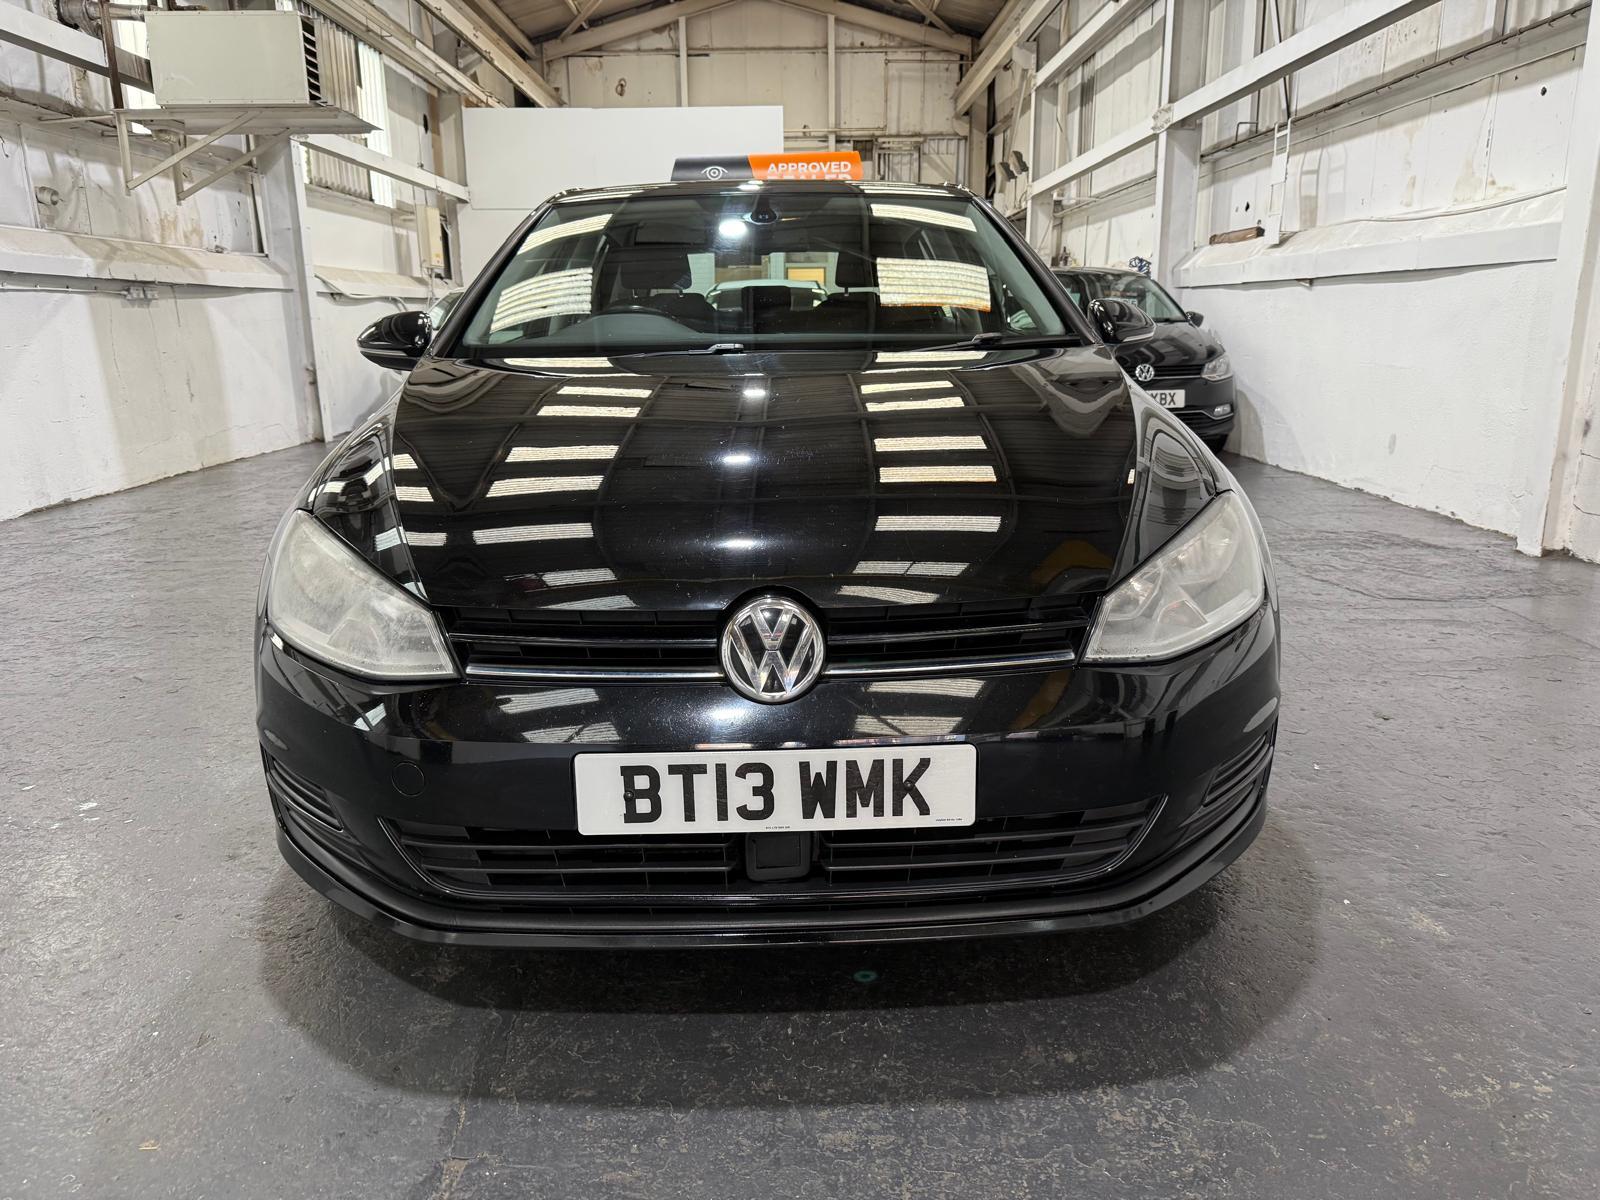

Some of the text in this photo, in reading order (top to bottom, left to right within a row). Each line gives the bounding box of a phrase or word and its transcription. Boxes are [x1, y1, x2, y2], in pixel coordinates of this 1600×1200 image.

[767, 161, 852, 174] APPROVED
[724, 600, 821, 700] VW
[619, 757, 931, 823] BT13 WMK
